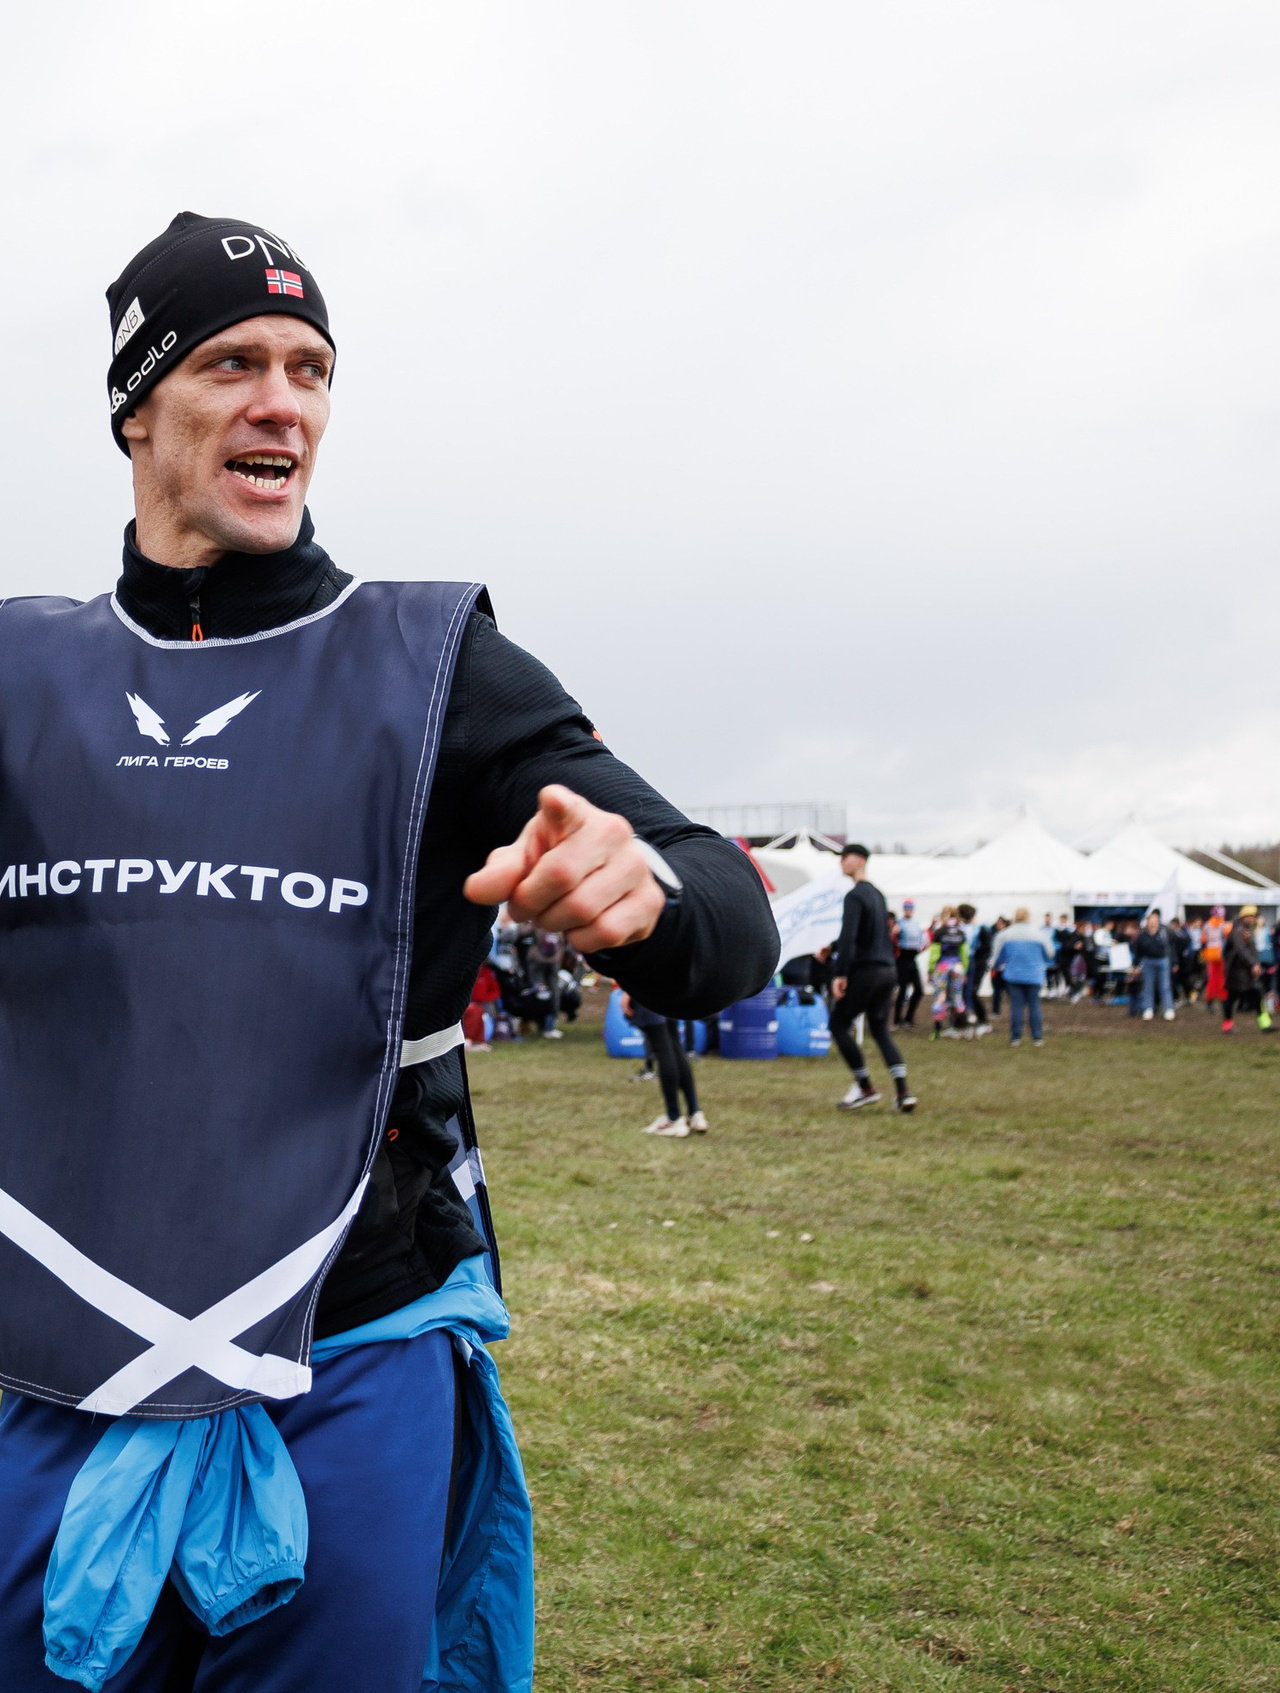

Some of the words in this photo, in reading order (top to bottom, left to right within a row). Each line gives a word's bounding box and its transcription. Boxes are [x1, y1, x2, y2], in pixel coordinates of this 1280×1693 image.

[127, 331, 177, 391] odlo
[116, 756, 159, 767] ЛИГА
[164, 757, 229, 770] ГЕРОЕВ
